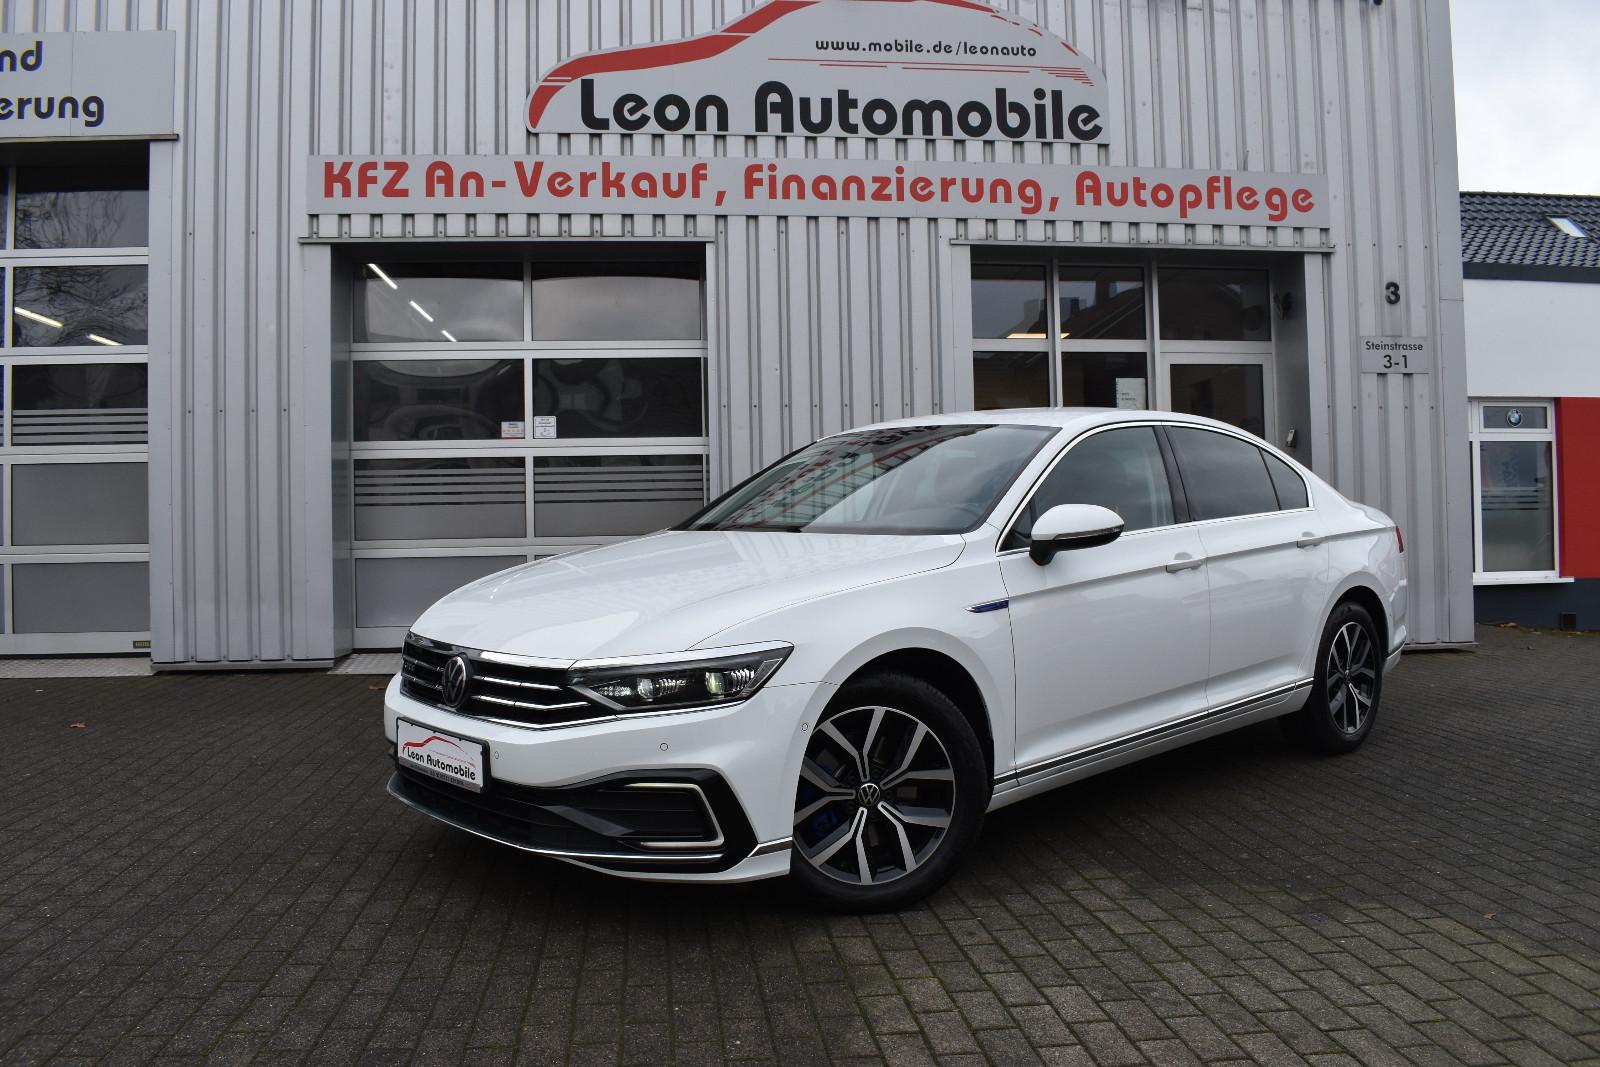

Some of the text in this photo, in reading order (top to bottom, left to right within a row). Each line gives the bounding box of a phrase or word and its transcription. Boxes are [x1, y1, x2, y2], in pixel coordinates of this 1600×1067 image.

[815, 39, 1037, 57] www.mobile.de/leonauto
[580, 78, 1104, 142] Leon Automobile
[324, 160, 1315, 222] KFZ An-Verkauf, Finanzierung, Autopflege
[1385, 281, 1401, 305] 3
[1365, 340, 1424, 351] Steinstrasse
[1383, 354, 1408, 369] 3-1
[407, 746, 425, 764] Leon
[426, 754, 477, 781] Automobile
